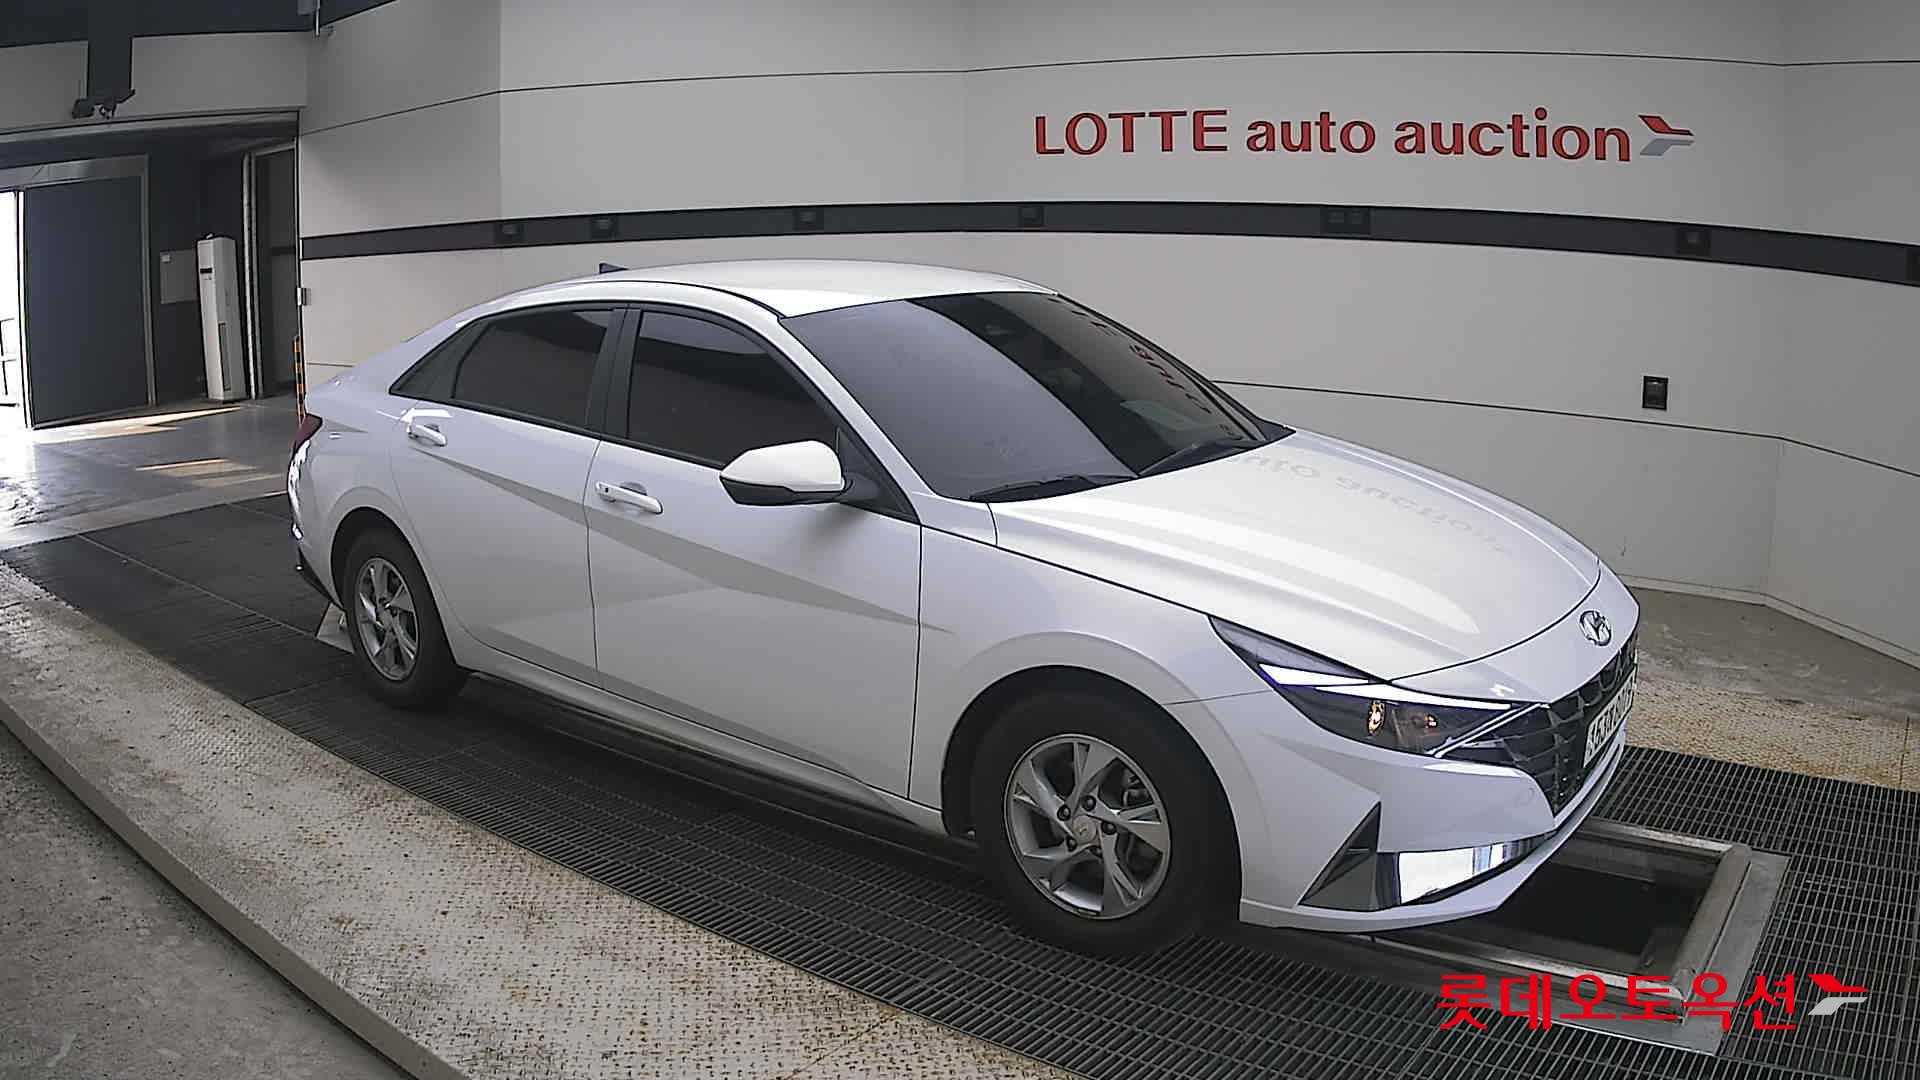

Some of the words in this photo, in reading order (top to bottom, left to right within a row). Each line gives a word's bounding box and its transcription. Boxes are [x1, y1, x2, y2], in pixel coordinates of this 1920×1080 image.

[1035, 110, 1229, 155] LOTTE
[1246, 111, 1376, 154] auto
[1394, 107, 1631, 162] auction
